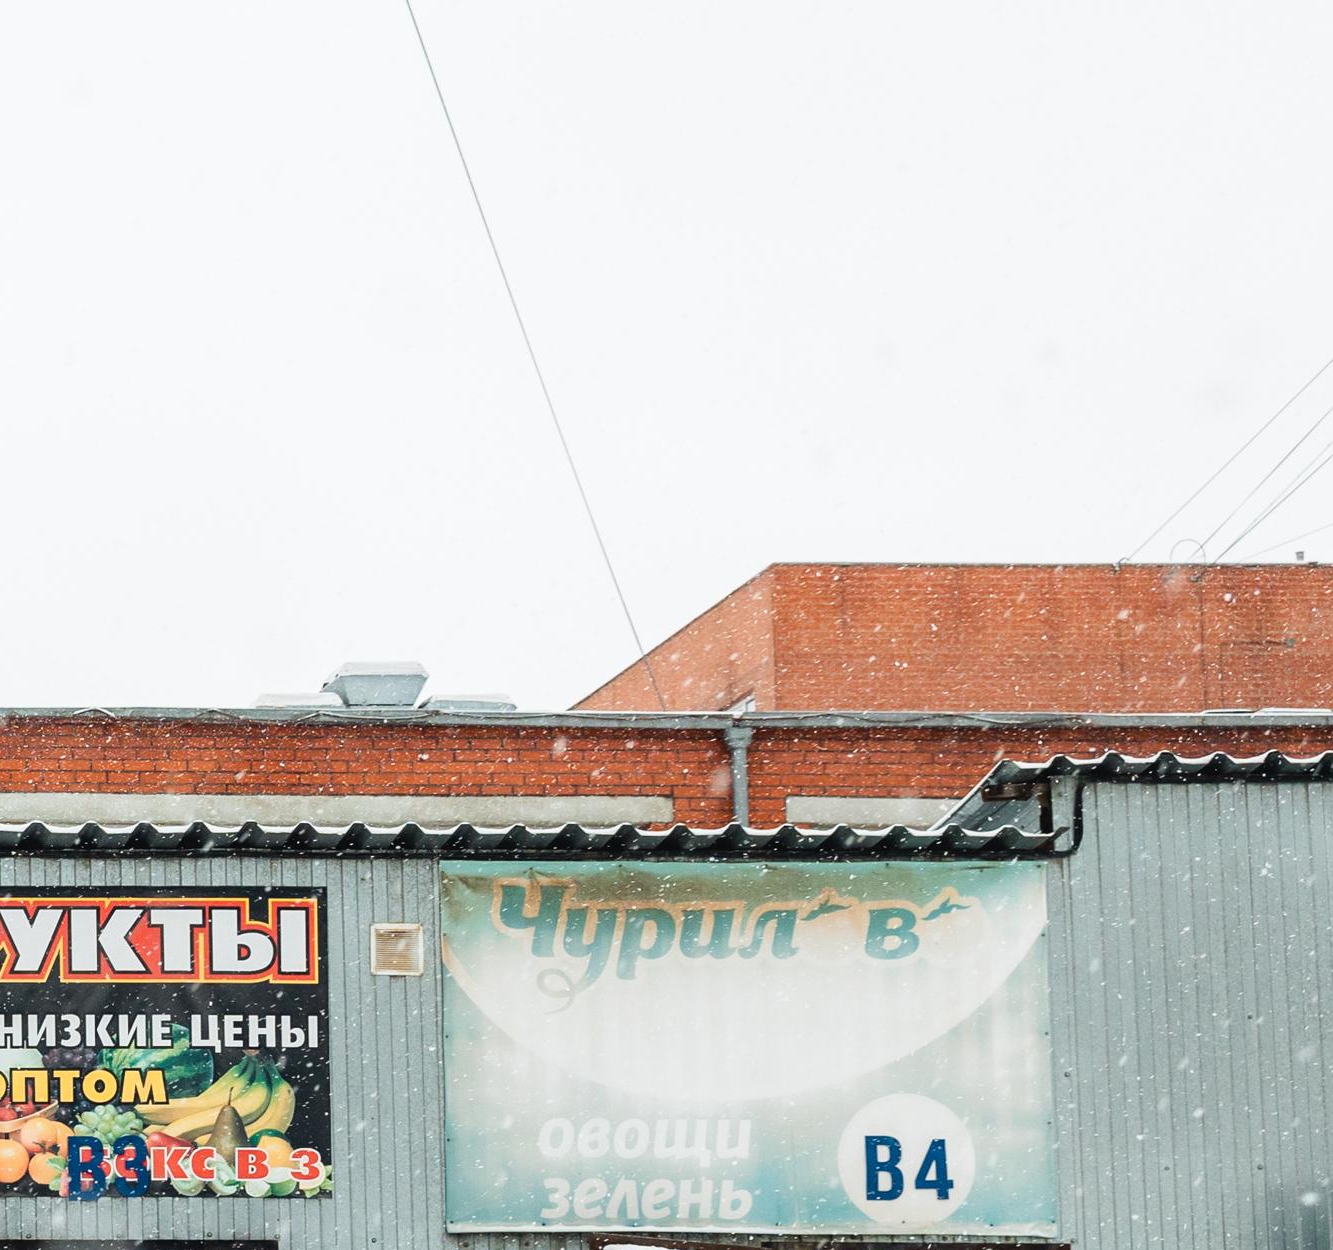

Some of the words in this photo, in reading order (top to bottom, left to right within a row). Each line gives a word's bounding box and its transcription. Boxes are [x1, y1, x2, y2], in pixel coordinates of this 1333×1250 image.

[189, 1013, 319, 1054] ЦЕНЫ
[236, 1146, 270, 1181] В
[289, 1146, 322, 1181] 3
[538, 1117, 751, 1168] овощи
[540, 1177, 753, 1220] зелень
